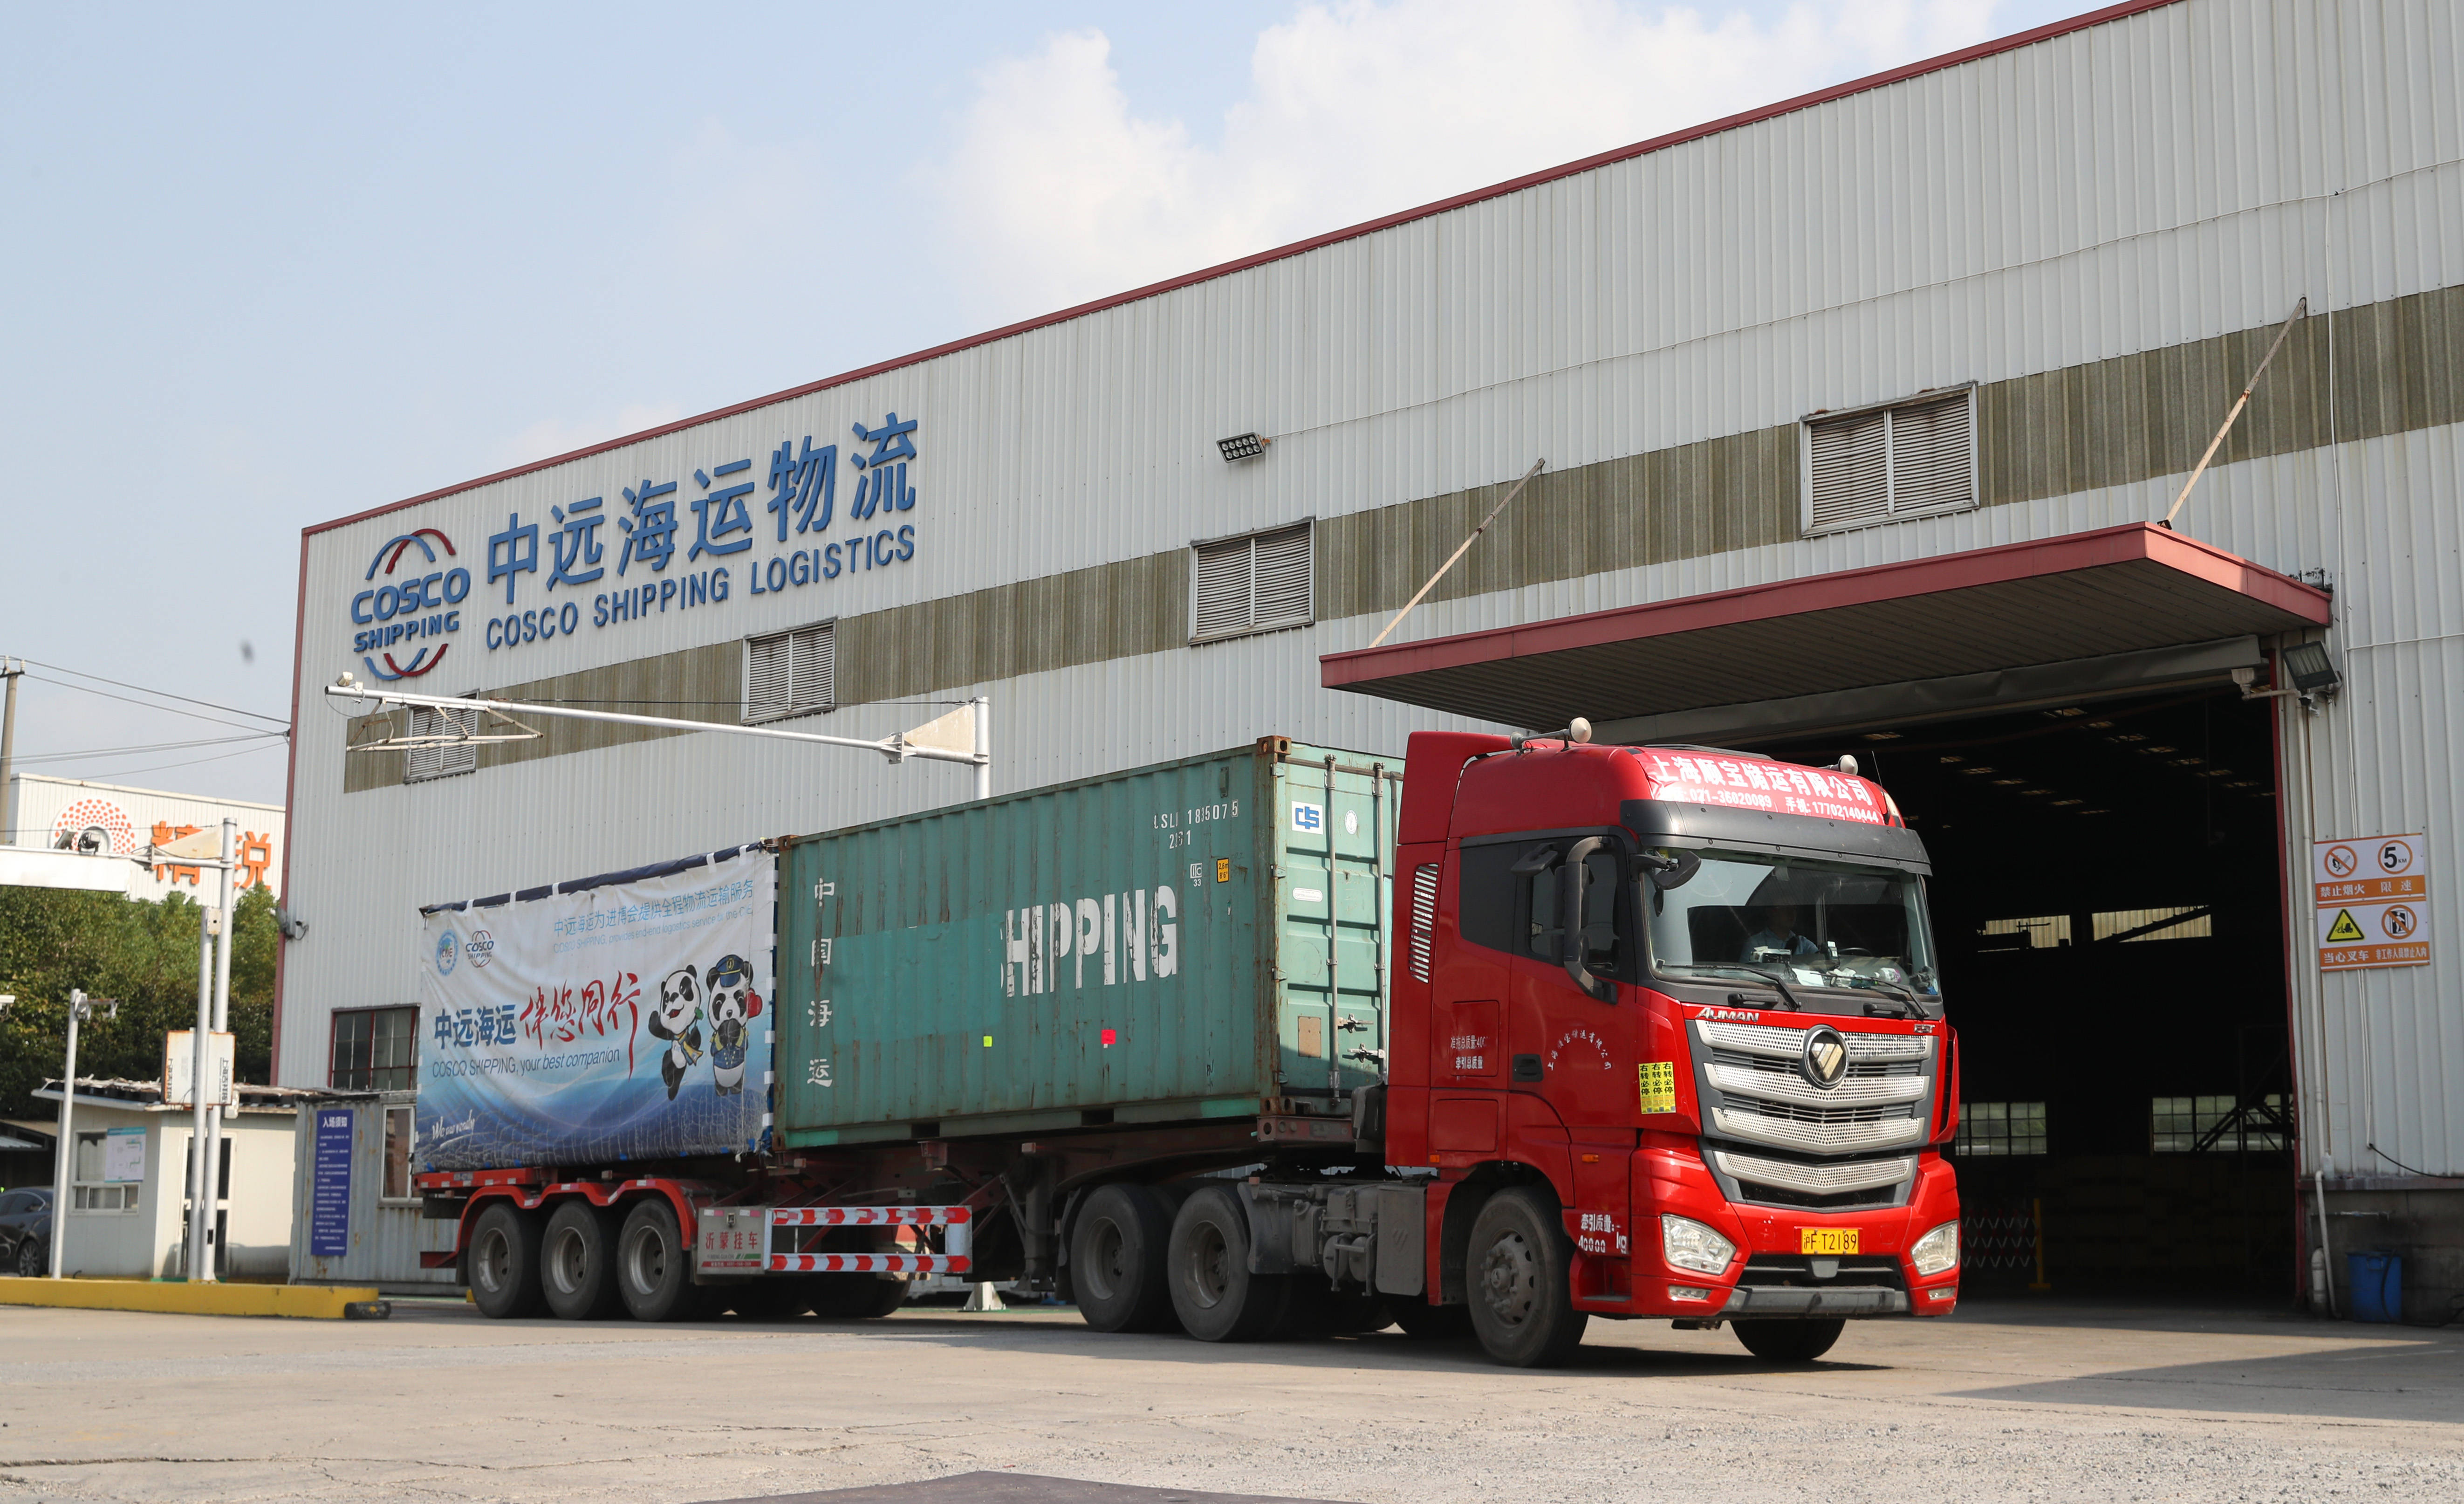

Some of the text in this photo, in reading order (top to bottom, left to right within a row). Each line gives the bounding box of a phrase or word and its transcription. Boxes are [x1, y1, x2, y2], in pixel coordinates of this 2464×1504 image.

[487, 412, 917, 604] 中远海运物流
[351, 568, 471, 625] COSCO
[486, 524, 915, 650] COSCO SHIPPING LOGISTICS
[353, 611, 459, 652] SHIPPING
[1653, 755, 1872, 806] 上海顺宝储运有限公司
[2384, 846, 2397, 868] 5
[1193, 879, 1201, 887] 33
[2320, 884, 2366, 897] 禁止烟火
[554, 879, 753, 938] 中远海运为进博会提供全程物流运输服务
[609, 928, 635, 944] provides
[692, 915, 716, 928] service
[726, 910, 738, 920] the
[1000, 886, 1177, 997] HIPPING
[466, 941, 494, 952] COSCO
[2324, 951, 2369, 963] 当心叉车
[2375, 947, 2427, 960] 非工作人员禁止入内
[434, 1004, 516, 1050] 中远海运
[1695, 1007, 1759, 1022] AUMAN
[433, 1047, 620, 1078] COSCO SHIPPING, your best companion
[1455, 1056, 1483, 1070] 牵引总质量
[1663, 1063, 1673, 1093] 右转必停
[1640, 1064, 1650, 1095] 右转必停
[1651, 1063, 1662, 1094] 右转必停
[705, 1231, 758, 1250] 沂蒙挂车
[1616, 1231, 1629, 1255] kg
